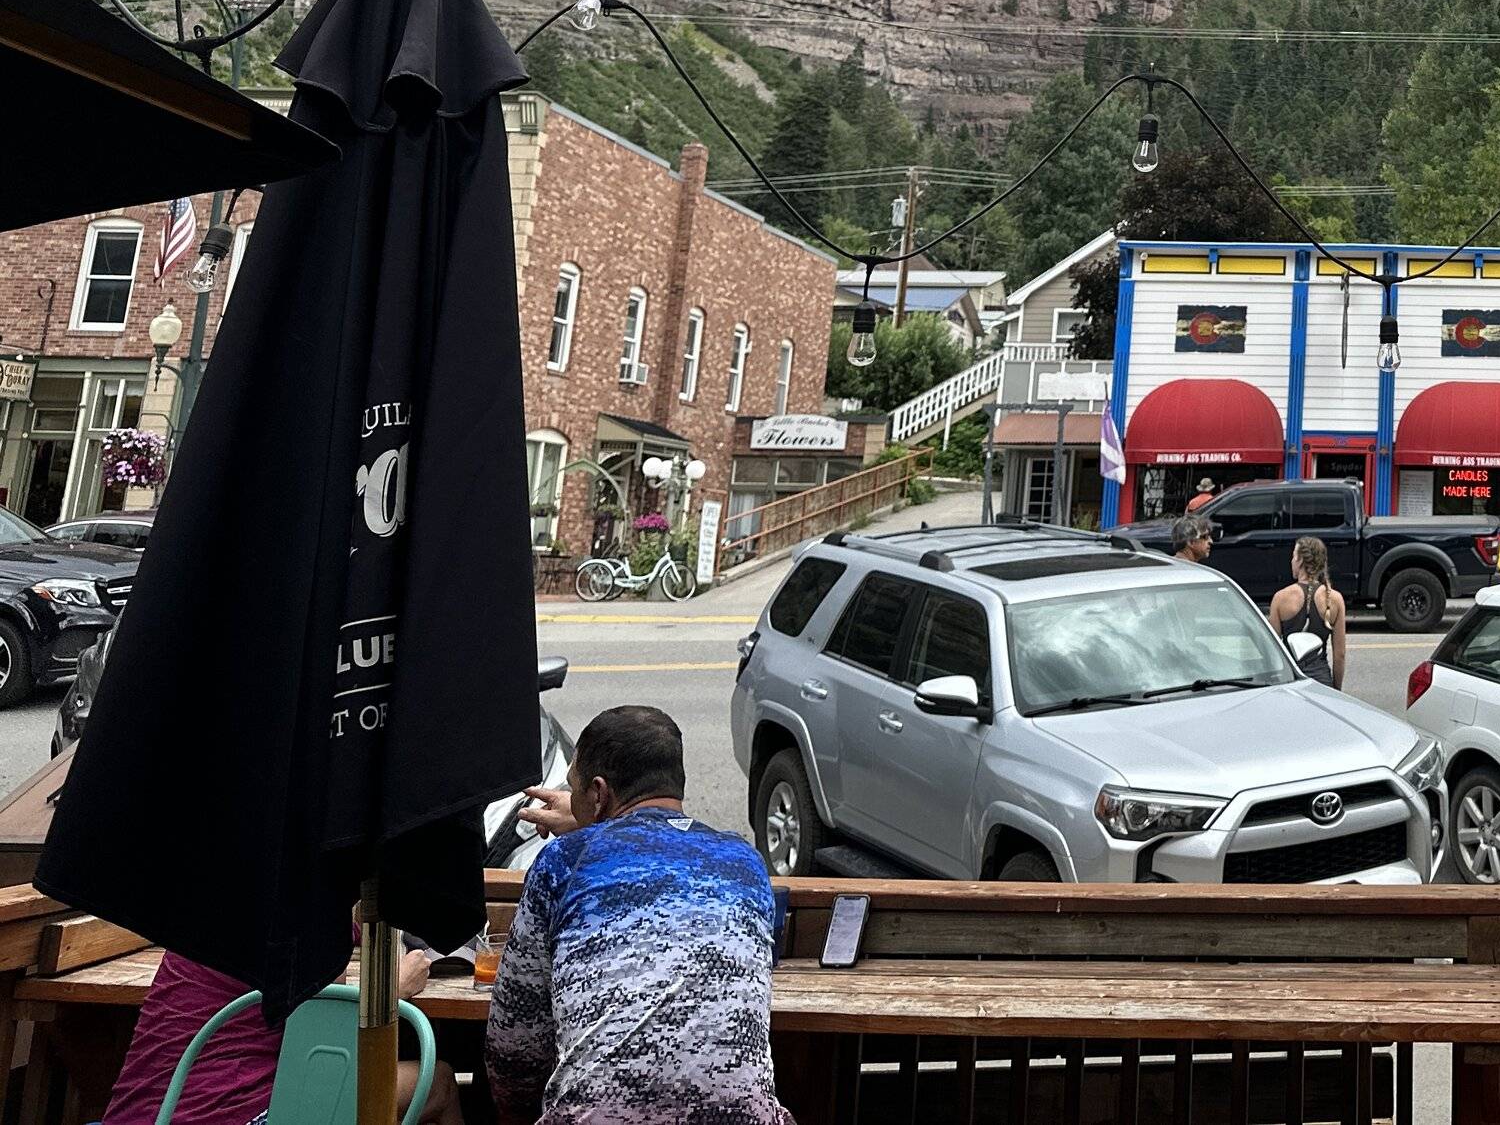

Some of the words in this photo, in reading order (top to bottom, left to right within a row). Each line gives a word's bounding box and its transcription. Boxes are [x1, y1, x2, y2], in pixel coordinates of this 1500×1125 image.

[757, 429, 835, 445] Flowers
[1186, 453, 1200, 463] ASS
[1200, 453, 1230, 463] TRADING
[1462, 455, 1476, 466] ASS
[1449, 470, 1489, 482] CANDLES
[1443, 486, 1468, 497] MADE
[1470, 486, 1492, 497] HERE
